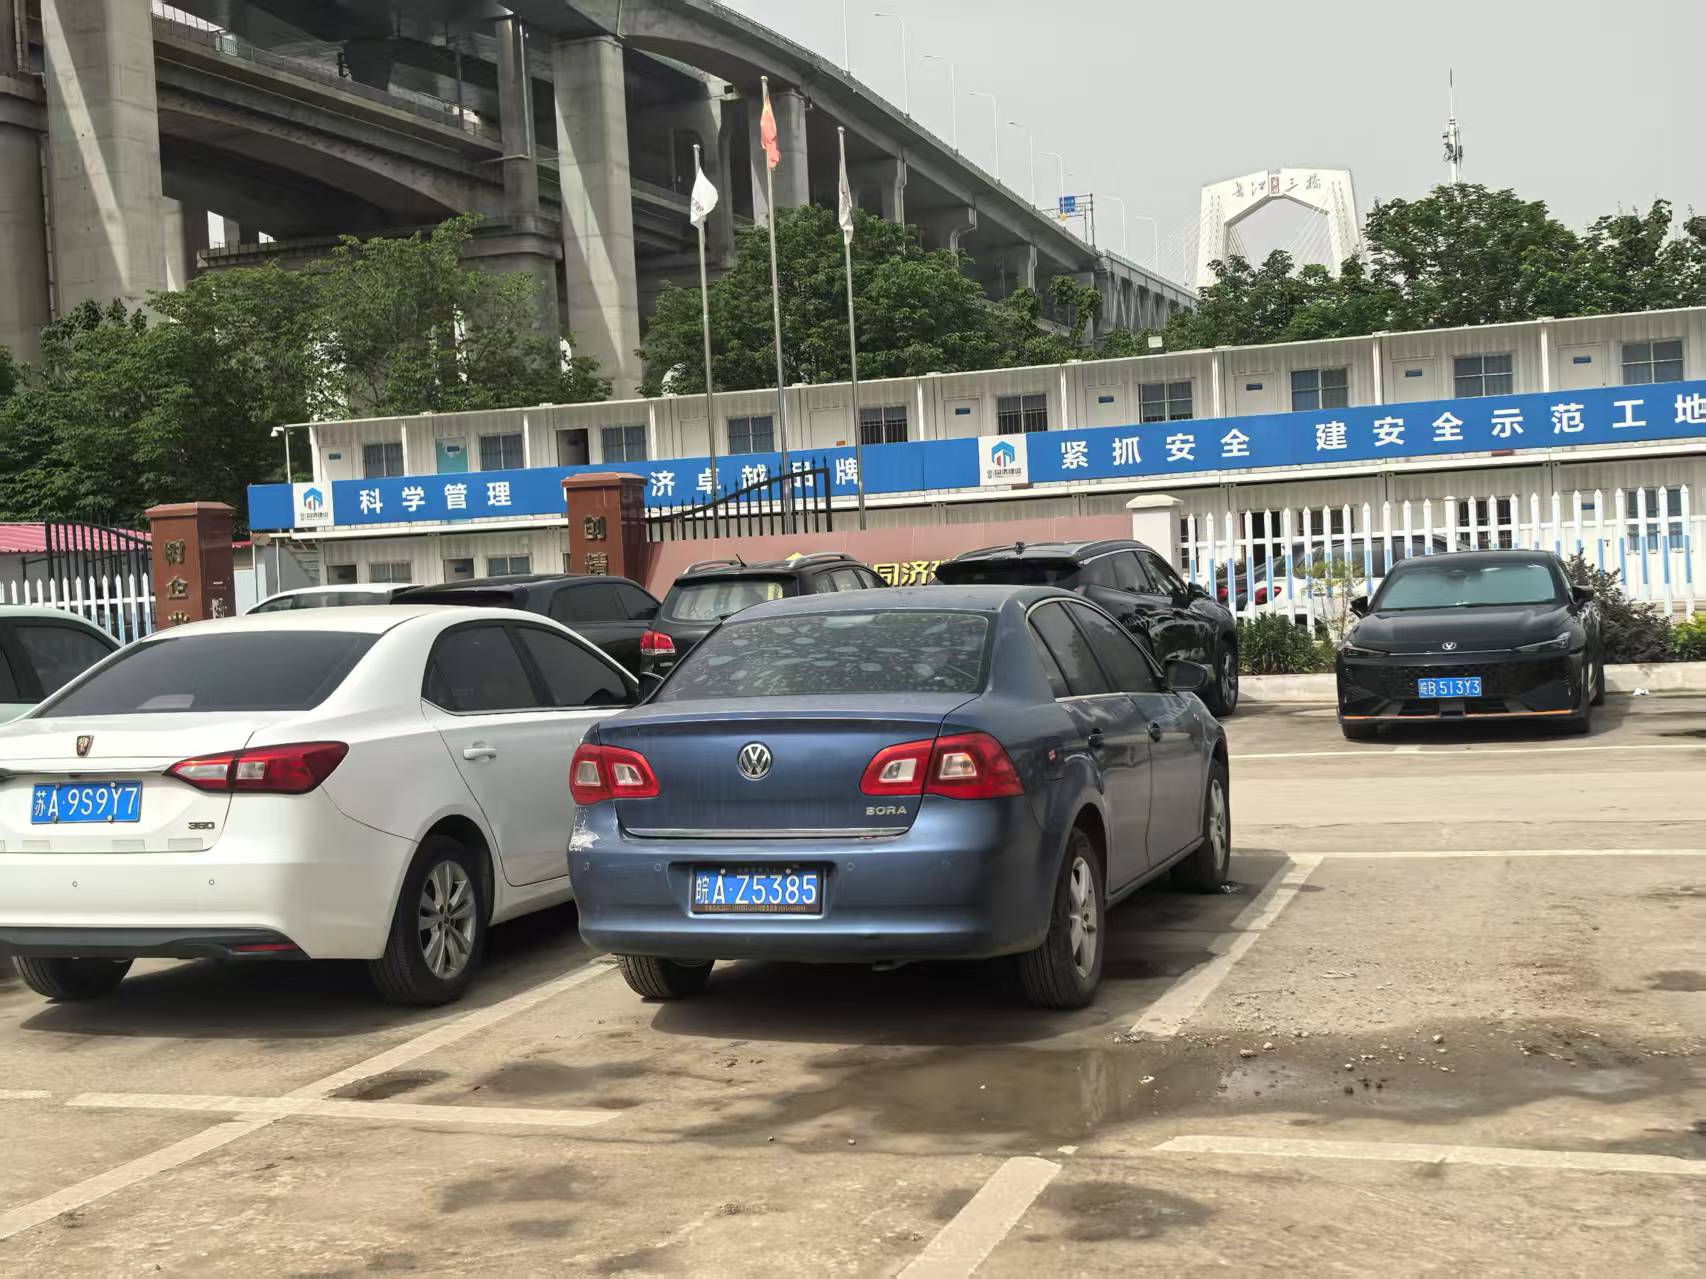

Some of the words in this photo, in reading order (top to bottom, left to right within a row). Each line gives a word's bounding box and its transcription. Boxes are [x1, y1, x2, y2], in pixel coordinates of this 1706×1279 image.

[1060, 428, 1250, 470] 紧抓安全
[1315, 393, 1706, 451] 建安全示范工地
[359, 481, 512, 515] 科学管理
[865, 806, 907, 816] BORA
